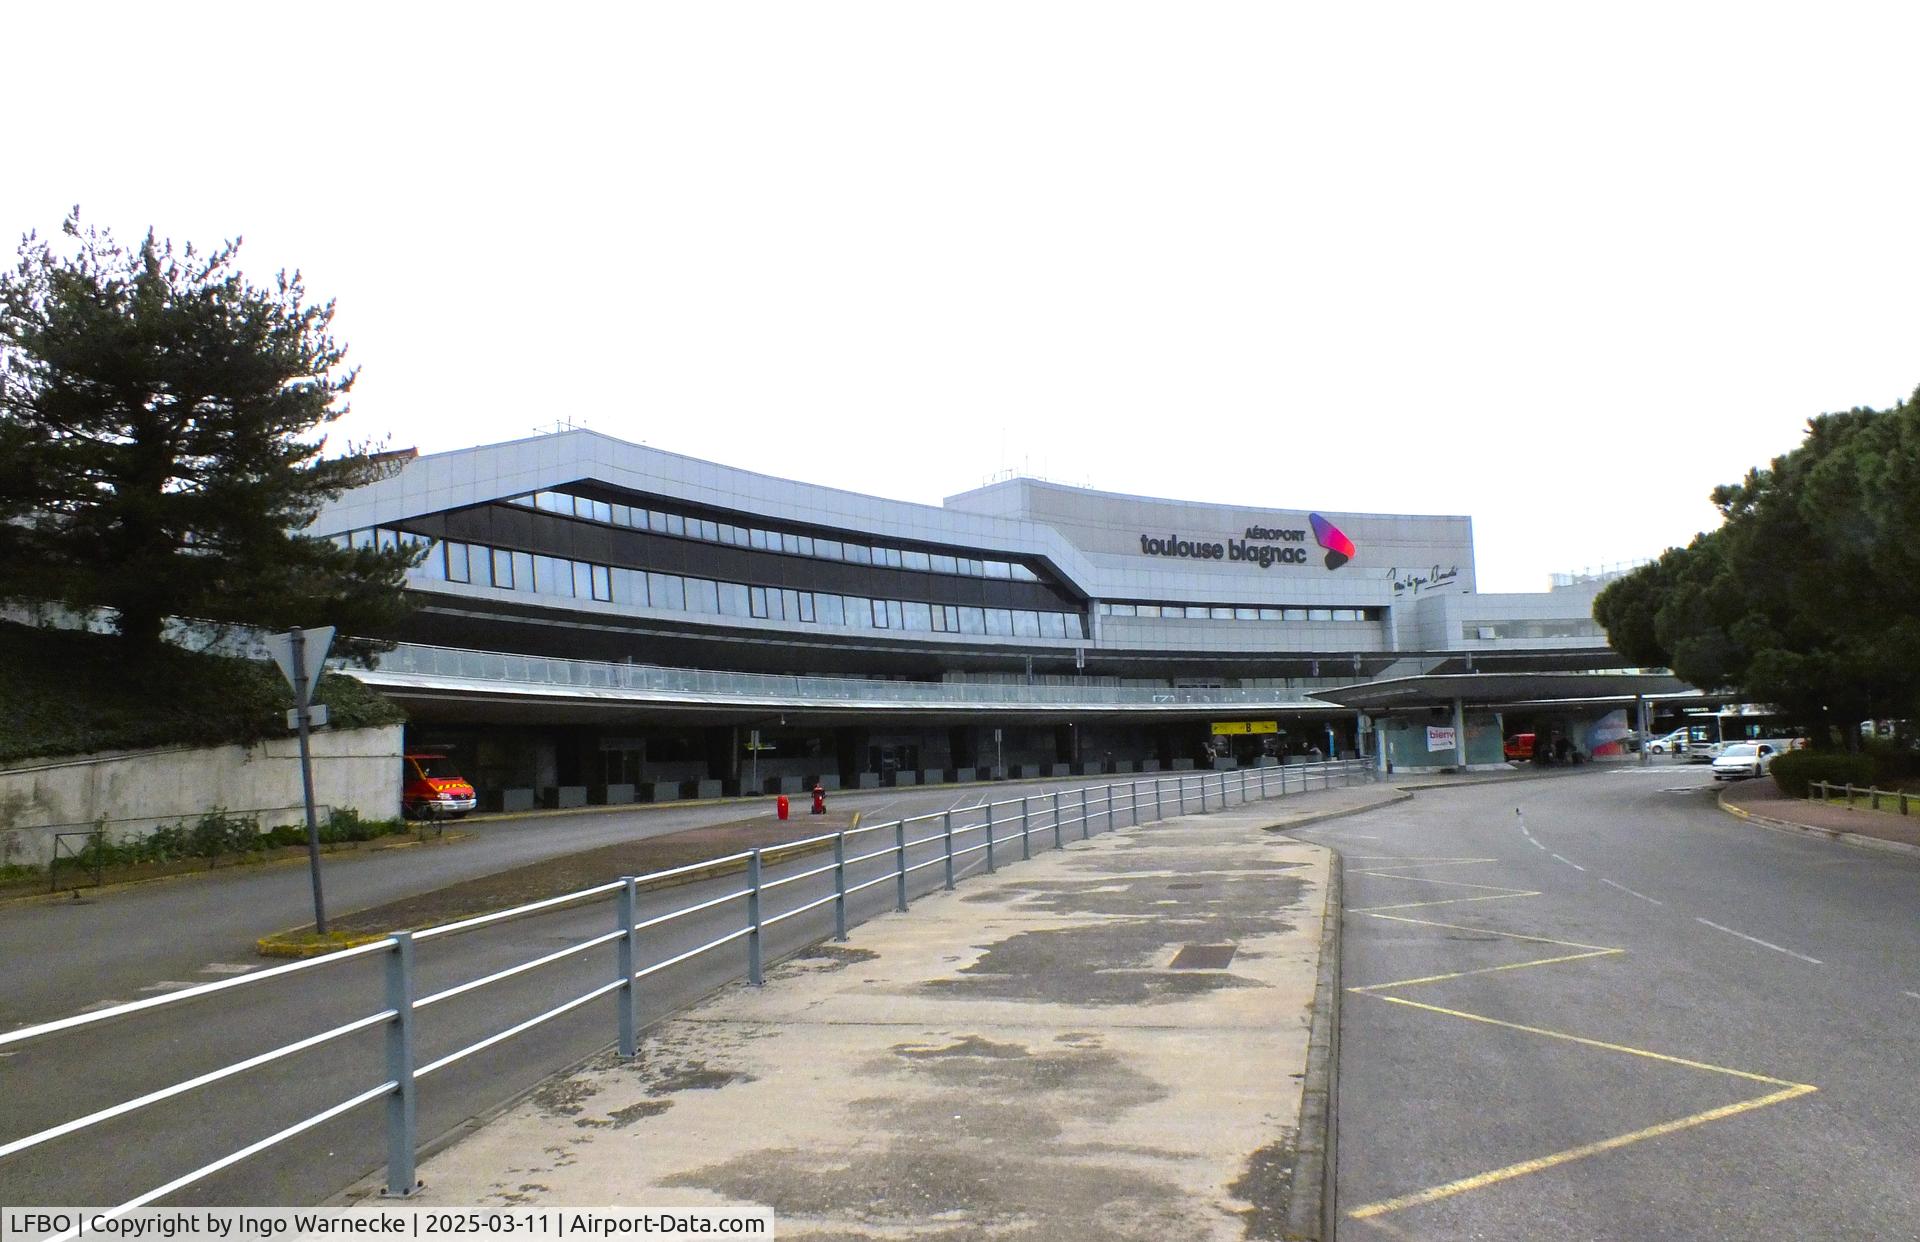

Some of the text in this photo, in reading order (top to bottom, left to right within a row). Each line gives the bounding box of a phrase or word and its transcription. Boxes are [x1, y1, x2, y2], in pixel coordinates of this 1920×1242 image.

[1245, 524, 1306, 542] AÉROPORT
[1140, 534, 1307, 569] toulouse blagnac
[1245, 722, 1252, 733] B
